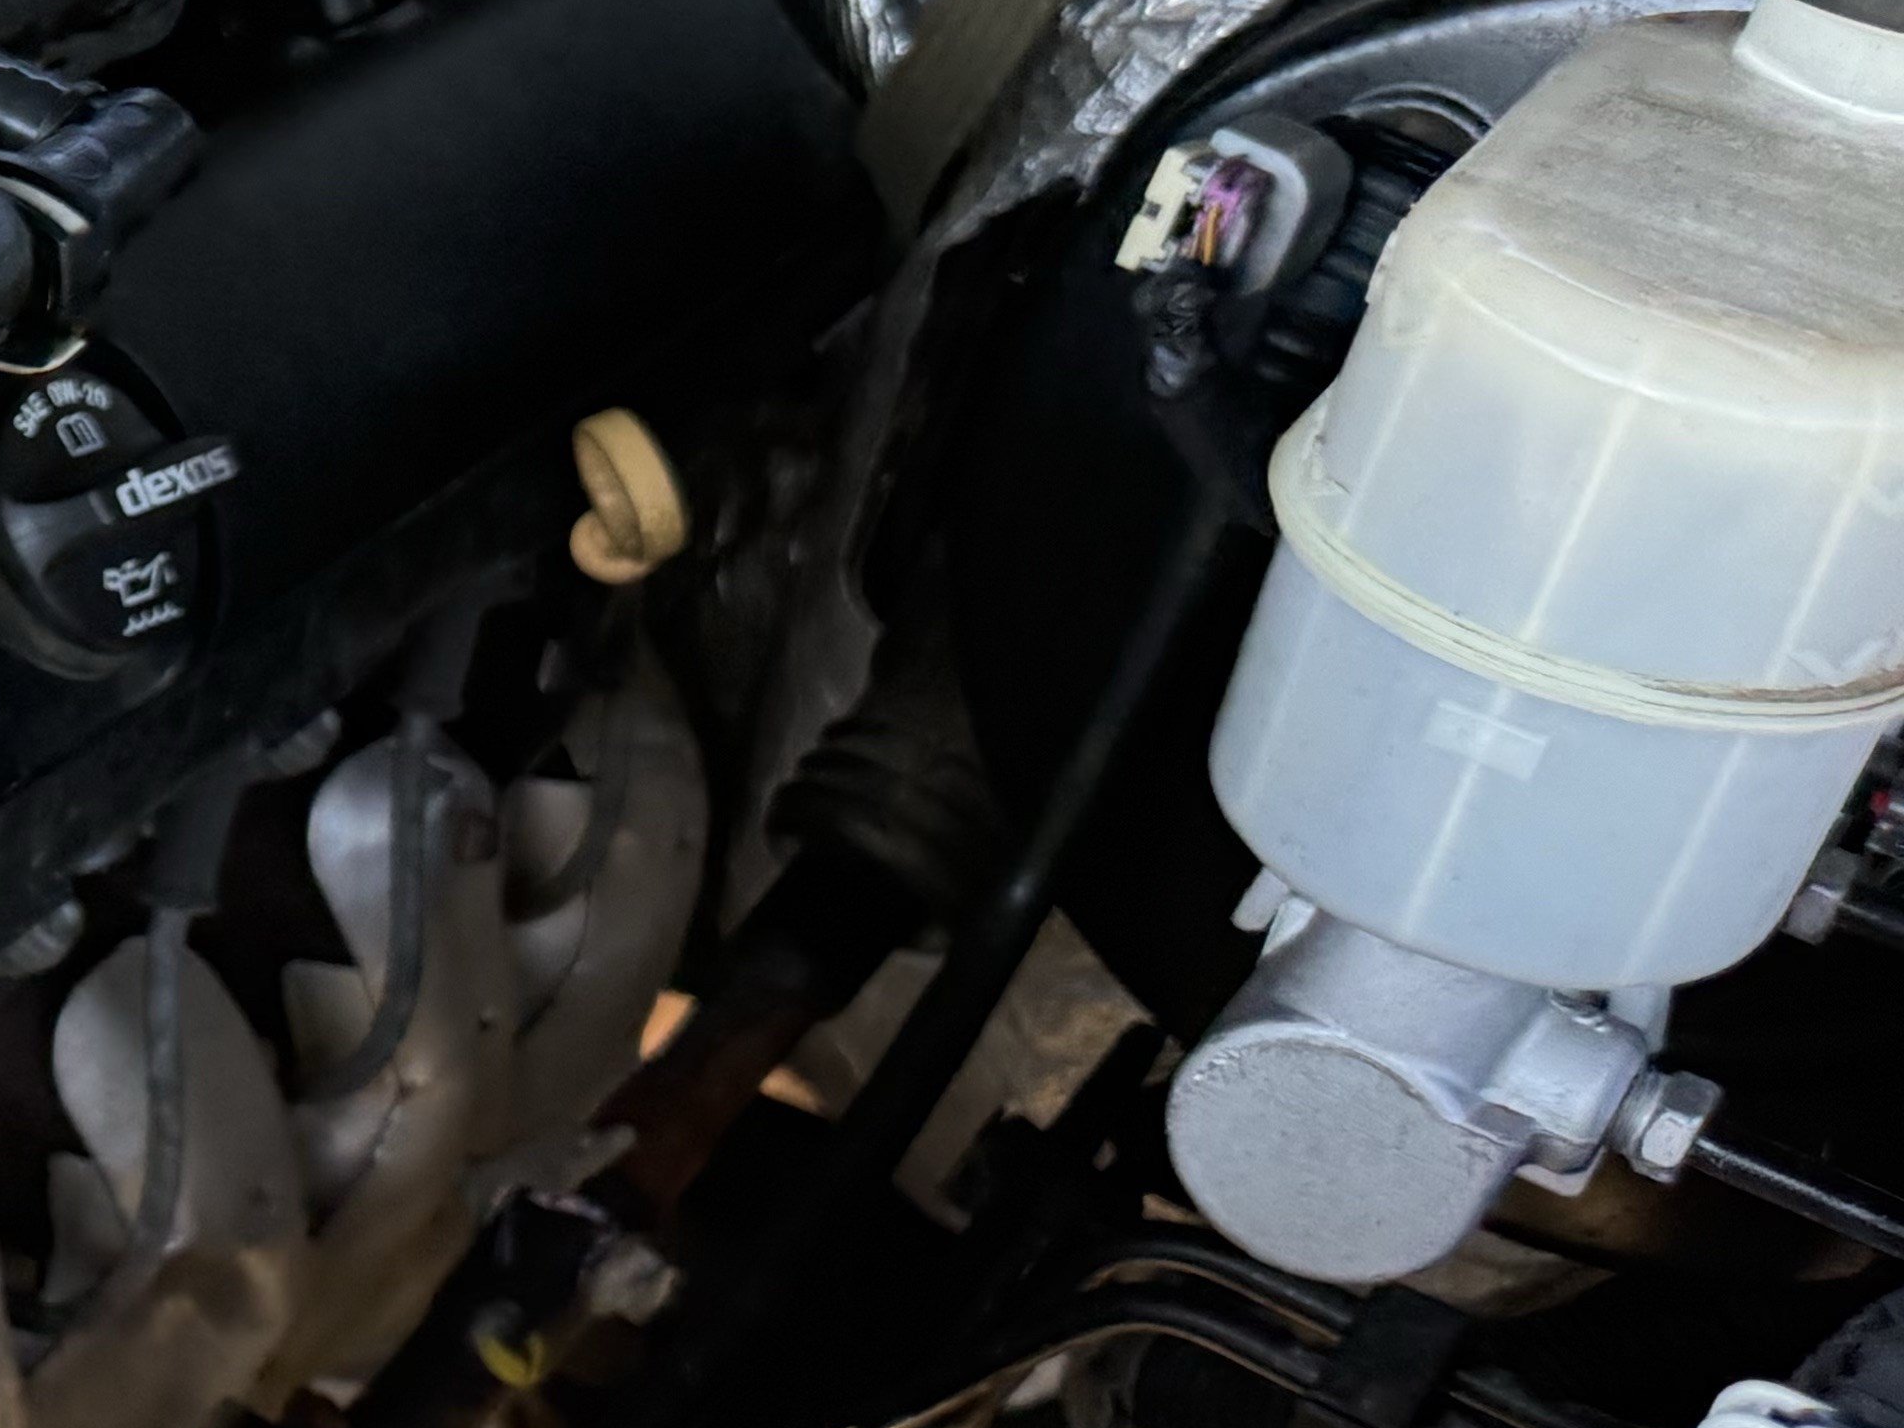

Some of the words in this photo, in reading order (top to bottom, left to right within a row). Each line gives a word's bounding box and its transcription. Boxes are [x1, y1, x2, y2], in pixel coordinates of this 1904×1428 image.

[12, 390, 54, 439] SAE
[46, 377, 114, 411] 0W-20
[115, 442, 240, 517] dexos
